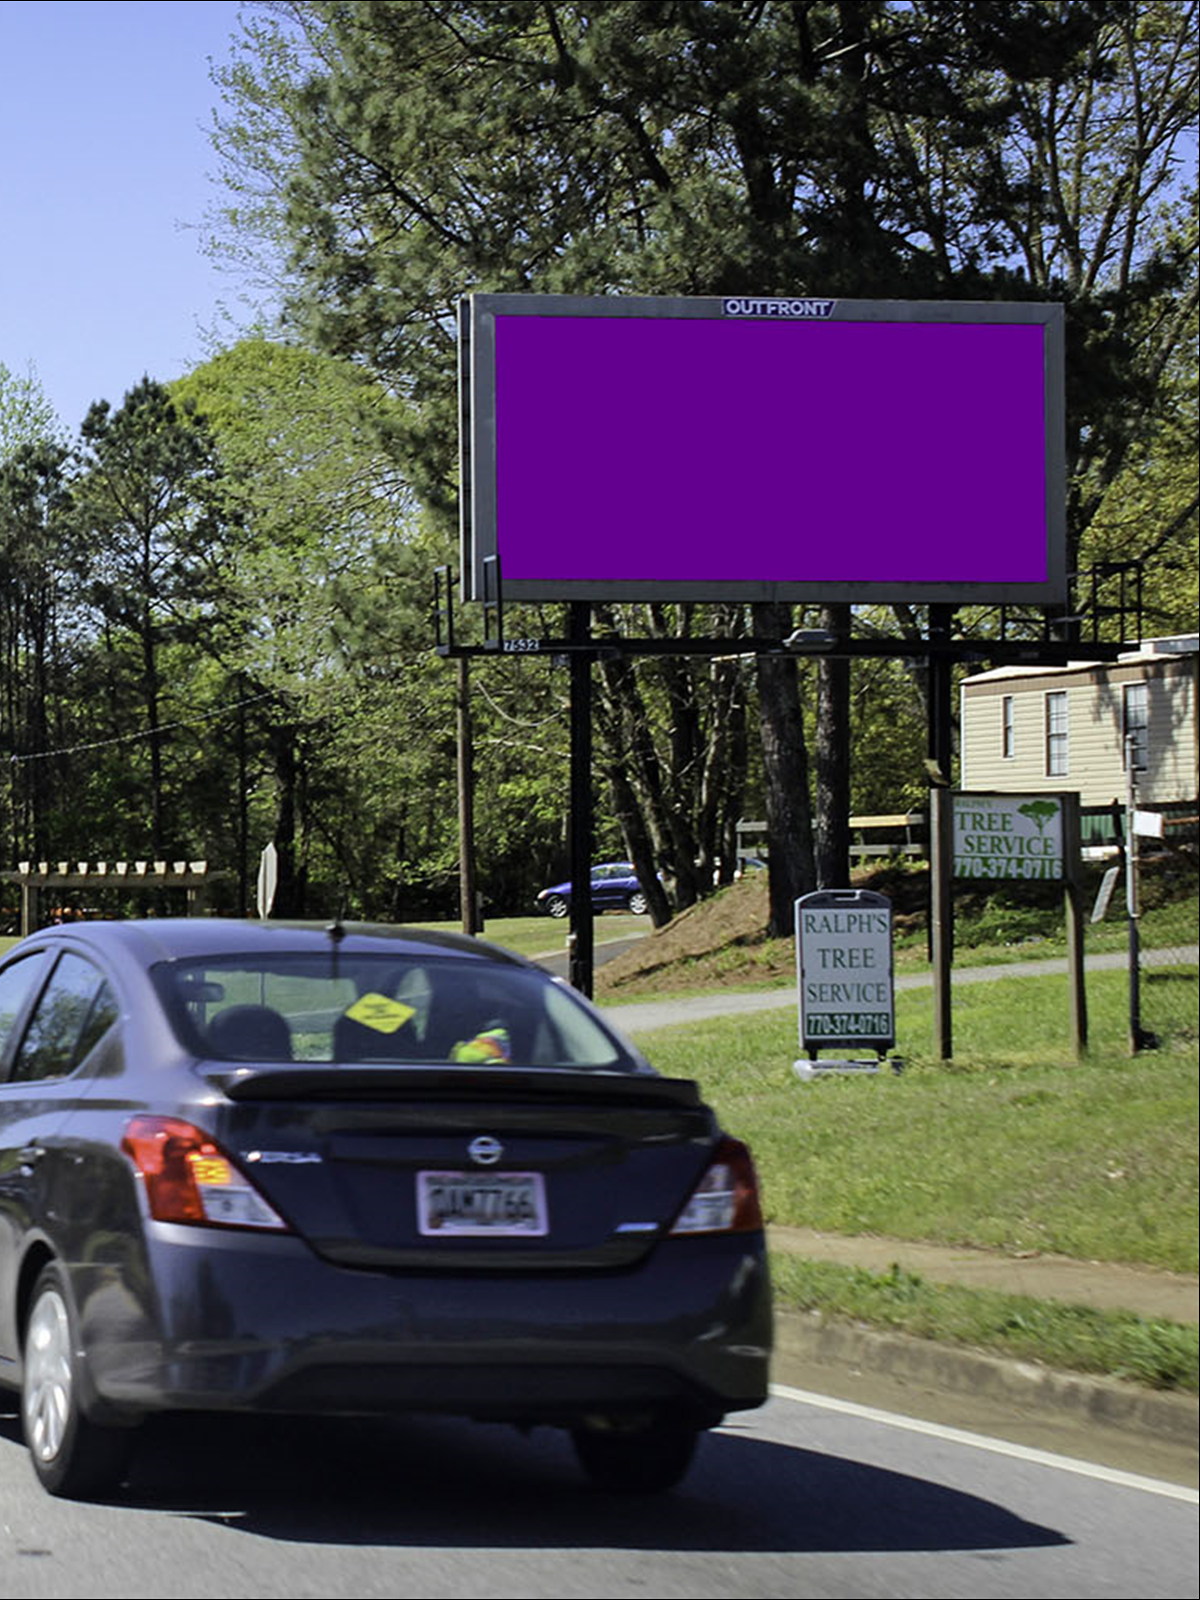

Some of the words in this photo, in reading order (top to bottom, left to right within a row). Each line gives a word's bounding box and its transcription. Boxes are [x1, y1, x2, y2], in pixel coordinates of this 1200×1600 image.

[726, 300, 830, 316] OUTFRONT
[955, 811, 1014, 832] TREE
[963, 834, 1055, 855] SERVICE
[954, 858, 1062, 879] 770-374-0716
[805, 913, 888, 934] RALPH'S
[817, 948, 876, 969] TREE
[807, 983, 887, 1003] SERVICE
[808, 1014, 888, 1034] 770-374-0716
